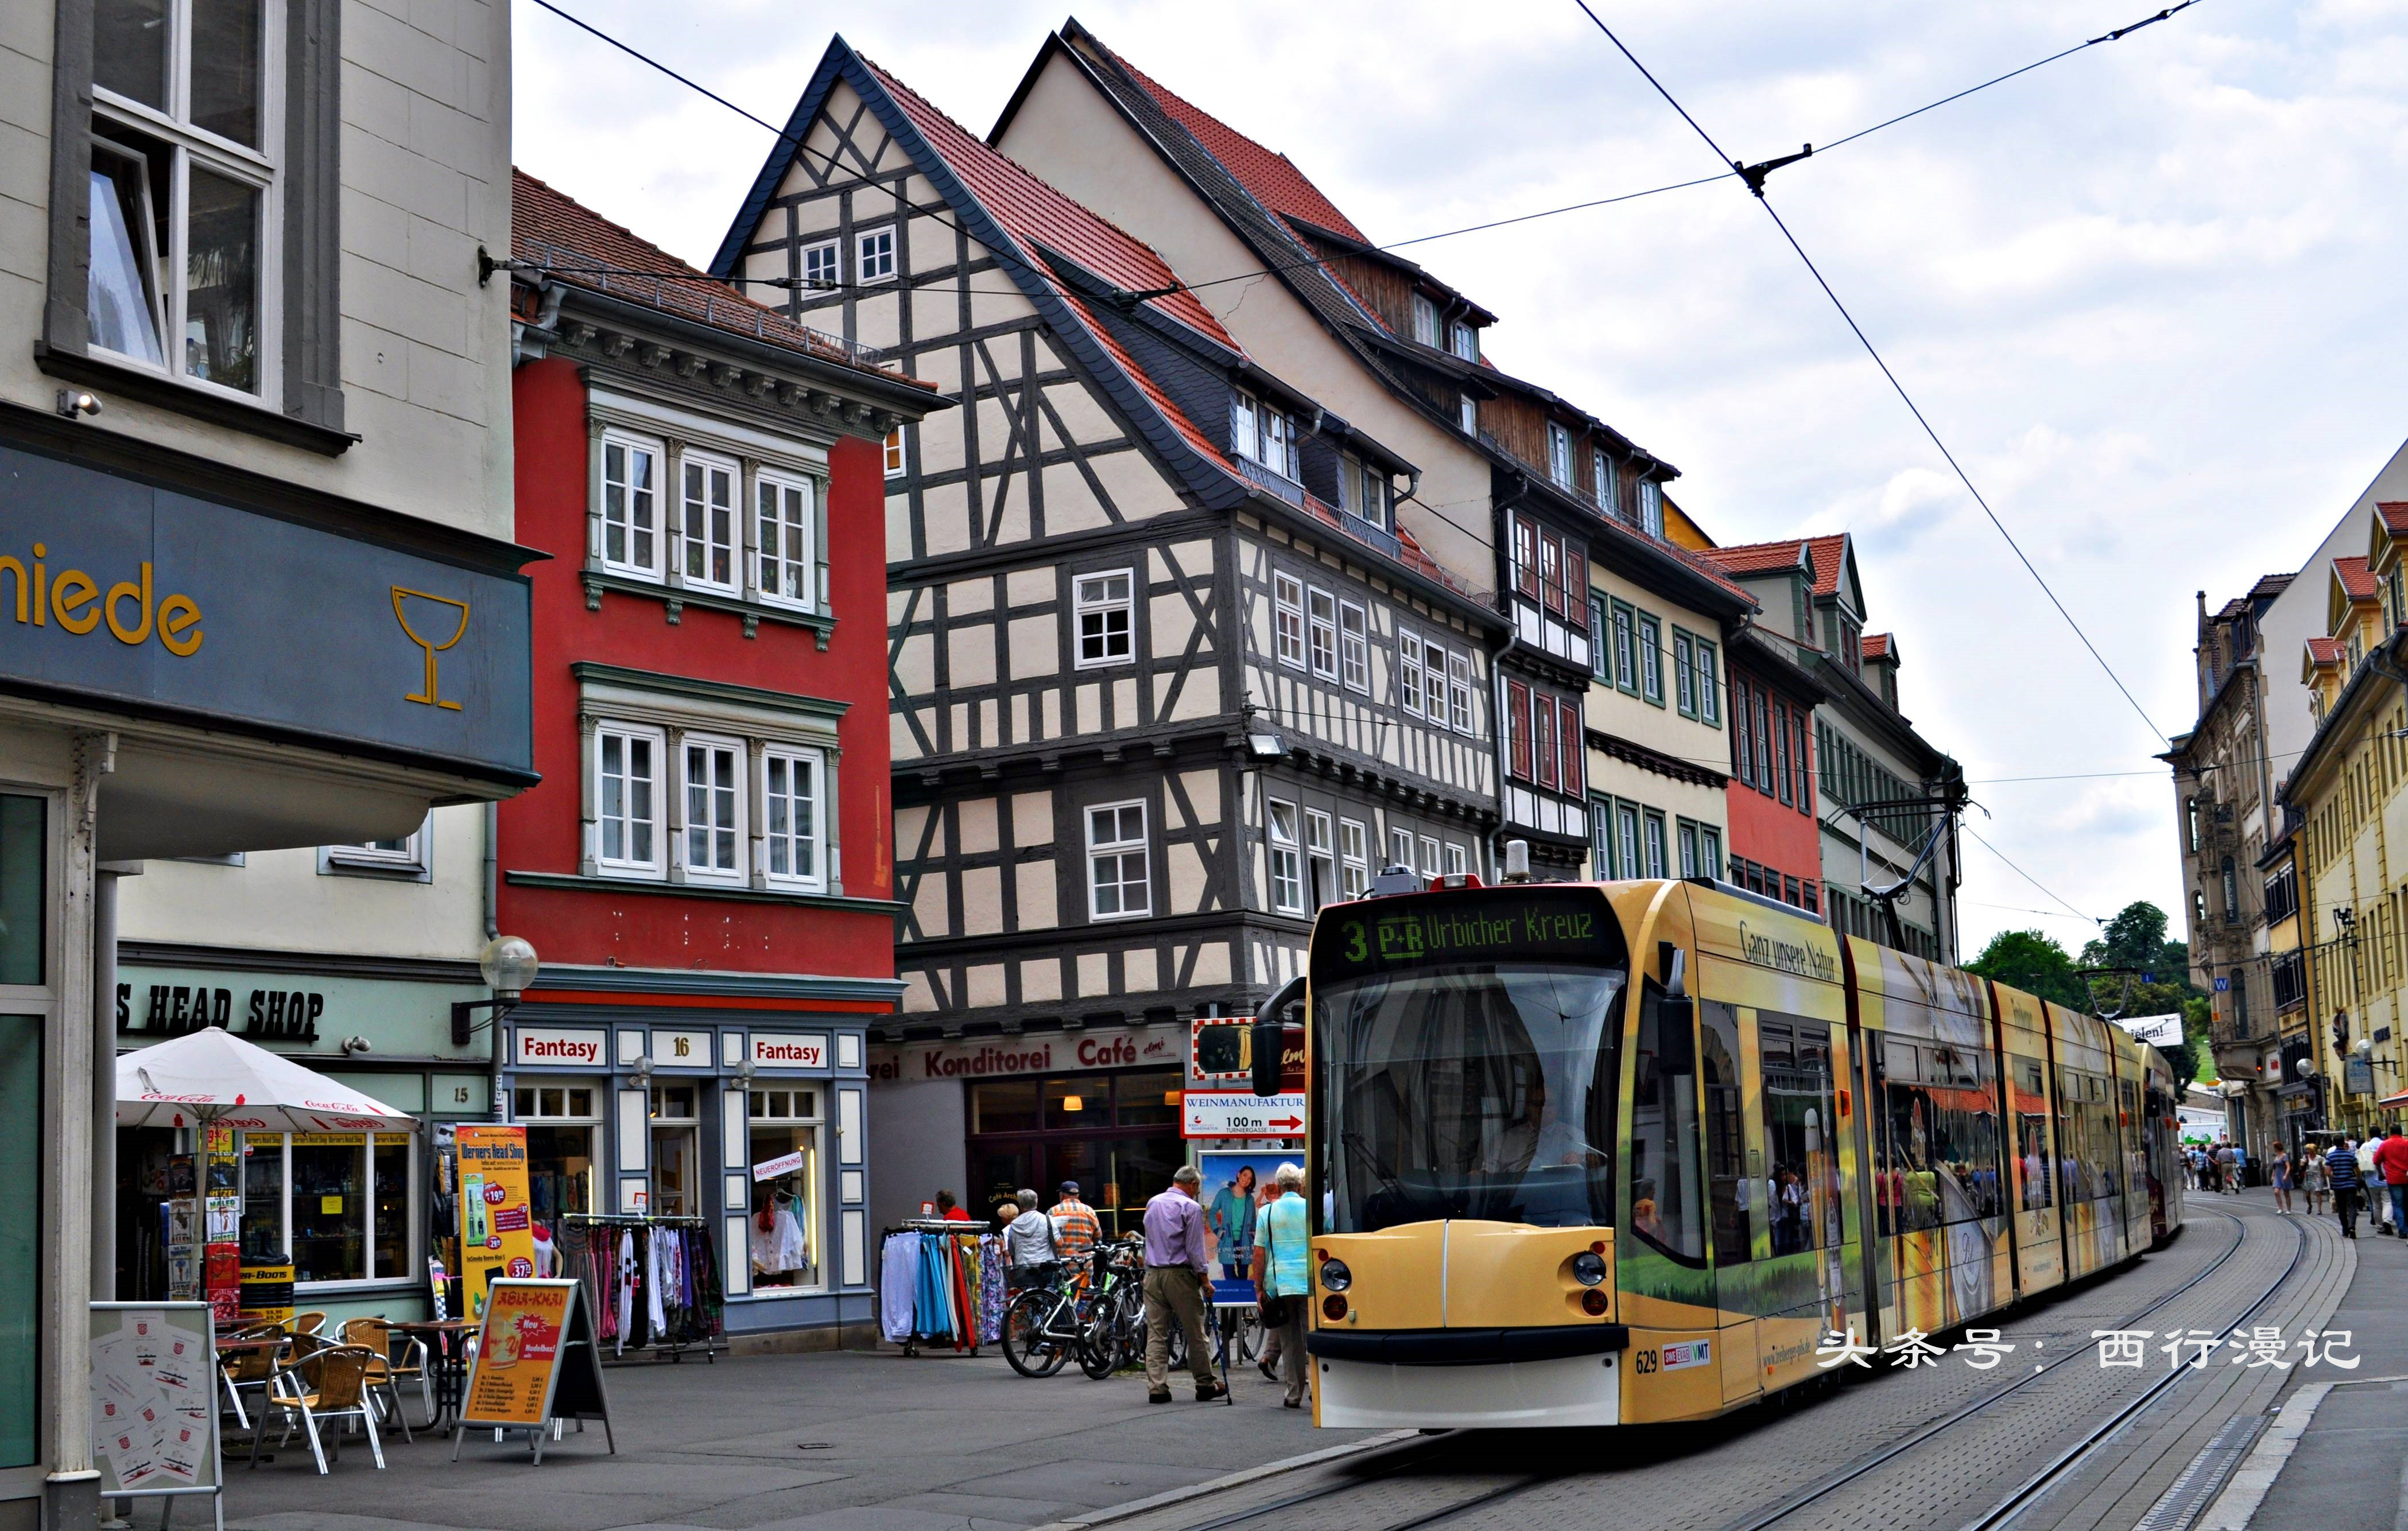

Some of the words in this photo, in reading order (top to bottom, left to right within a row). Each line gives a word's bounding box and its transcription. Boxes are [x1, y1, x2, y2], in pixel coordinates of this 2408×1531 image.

[1342, 920, 1367, 962] 3
[1378, 924, 1424, 953] P+R
[1427, 911, 1517, 949] Urbicher
[1524, 907, 1593, 942] Kreuz
[1739, 920, 1771, 965] Ganz
[1772, 940, 1807, 975] unsere
[1805, 939, 1835, 981] Natur
[2215, 979, 2228, 990] W
[147, 985, 232, 1031] HEAD
[247, 989, 324, 1035] SHOP
[524, 1037, 598, 1062] Fantasy
[673, 1037, 690, 1057] 16
[757, 1042, 820, 1064] Fantasy
[925, 1043, 1050, 1077] Konditorei
[1078, 1036, 1137, 1066] Café
[455, 1087, 469, 1103] 15
[1186, 1098, 1305, 1107] WEINMANUFAKTUR
[1226, 1117, 1249, 1127] 100
[1251, 1119, 1262, 1127] m
[461, 1143, 491, 1159] Werners
[491, 1143, 508, 1159] Head
[509, 1143, 525, 1163] Shop
[755, 1156, 801, 1176] NEUERÖFFNUNG
[523, 1320, 538, 1328] Neu
[525, 1344, 555, 1353] Nudelbox!
[1636, 1349, 1657, 1374] 629
[1665, 1350, 1677, 1363] SWE
[1677, 1349, 1690, 1361] EVAG
[1692, 1343, 1709, 1361] VMT
